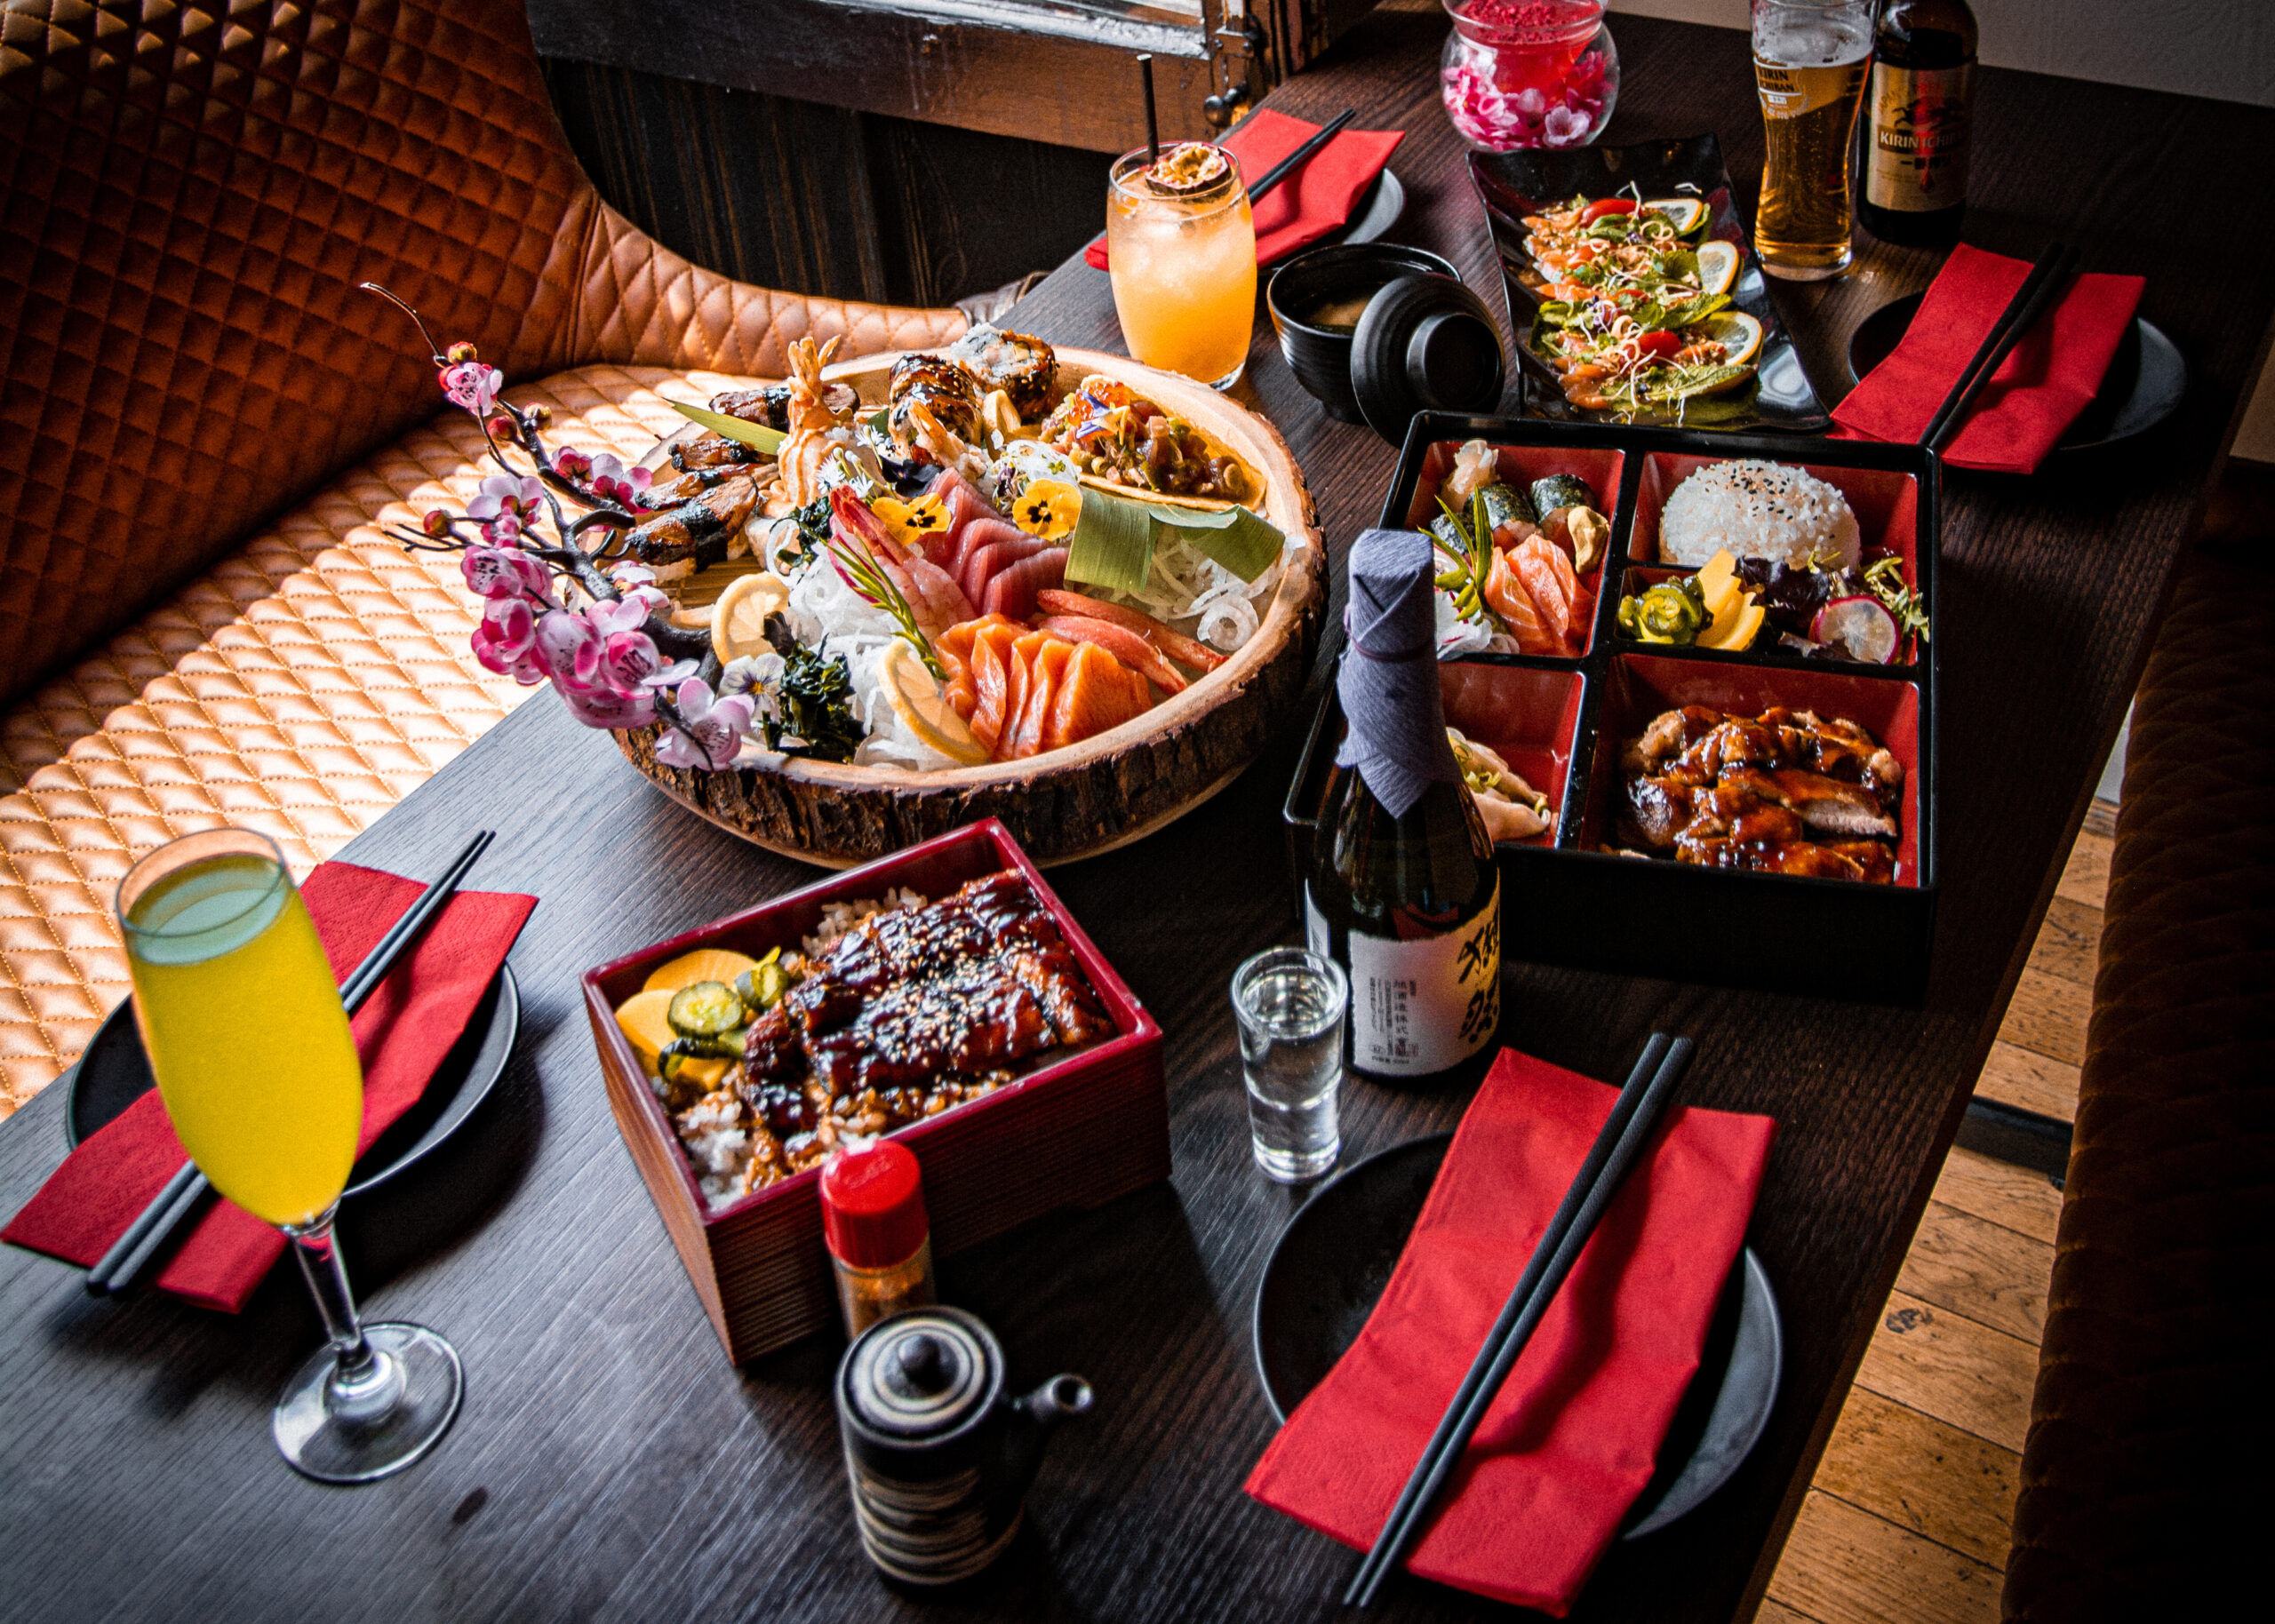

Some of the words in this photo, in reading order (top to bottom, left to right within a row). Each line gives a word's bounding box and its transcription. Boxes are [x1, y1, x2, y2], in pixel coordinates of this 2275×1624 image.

[1759, 68, 1788, 81] KIRIN
[1880, 131, 1920, 149] KIRIN
[1922, 129, 1965, 148] ICHI
